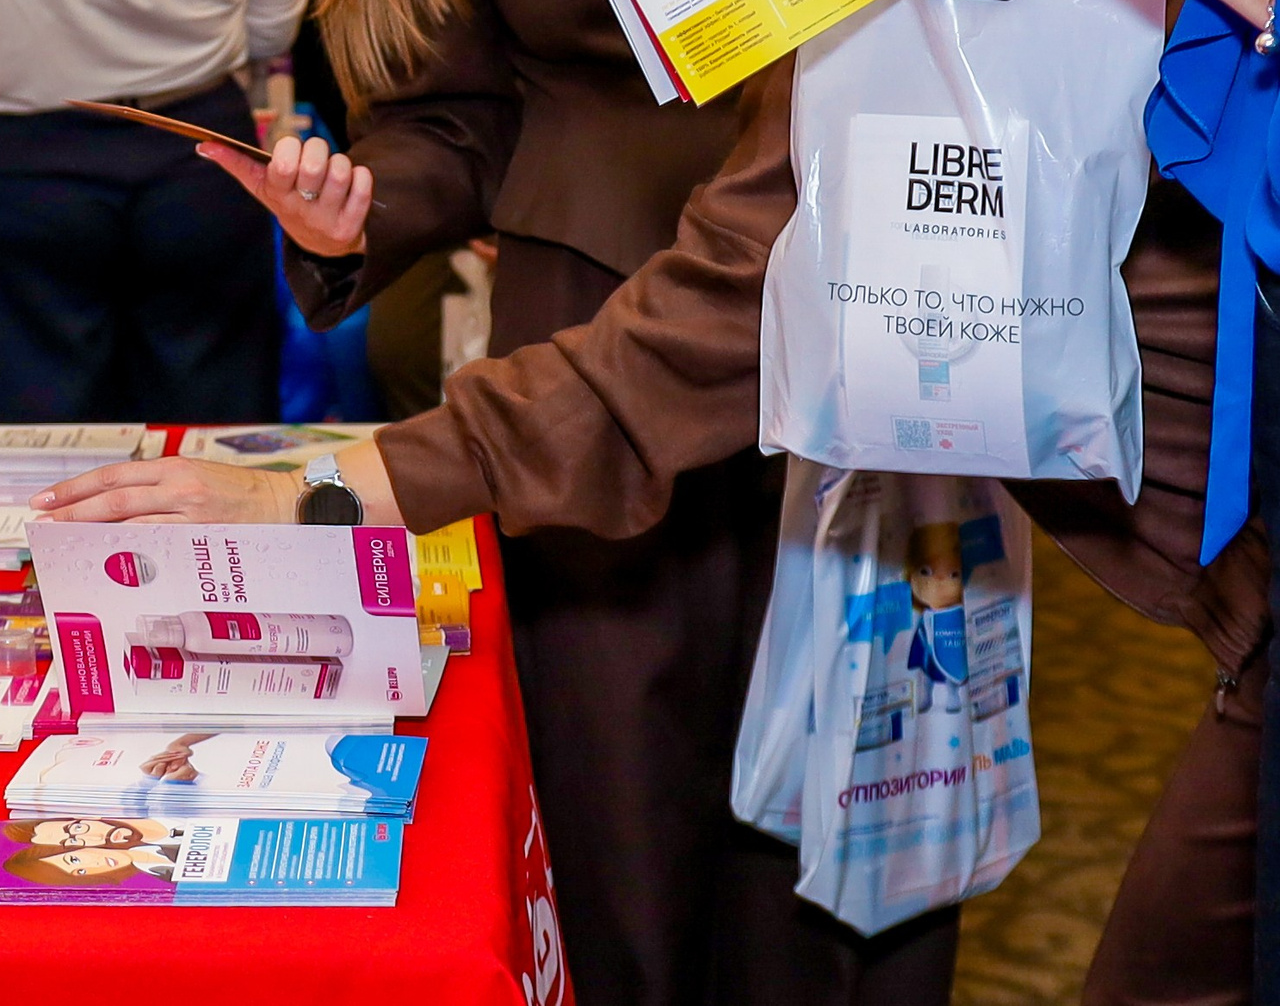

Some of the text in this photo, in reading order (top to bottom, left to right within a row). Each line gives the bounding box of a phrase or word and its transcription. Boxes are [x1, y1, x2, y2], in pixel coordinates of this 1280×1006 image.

[909, 141, 1004, 182] LIBRE
[905, 178, 1005, 219] DERM
[904, 222, 1007, 241] LABORATORIES
[827, 282, 1085, 318] ТОЛЬКО ТО, ЧТО НУЖНО
[883, 314, 1021, 344] ТВОЕЙ КОЖЕ
[191, 534, 219, 602] БОЛЬШЕ,
[369, 537, 391, 606] СИЛВЕРИО
[219, 582, 231, 603] чем
[69, 637, 91, 695] ИННОВАЦИИ
[79, 628, 105, 695] ДЕРМАТОЛОГИИ
[181, 825, 215, 878] ГЕНЕРОЛОН
